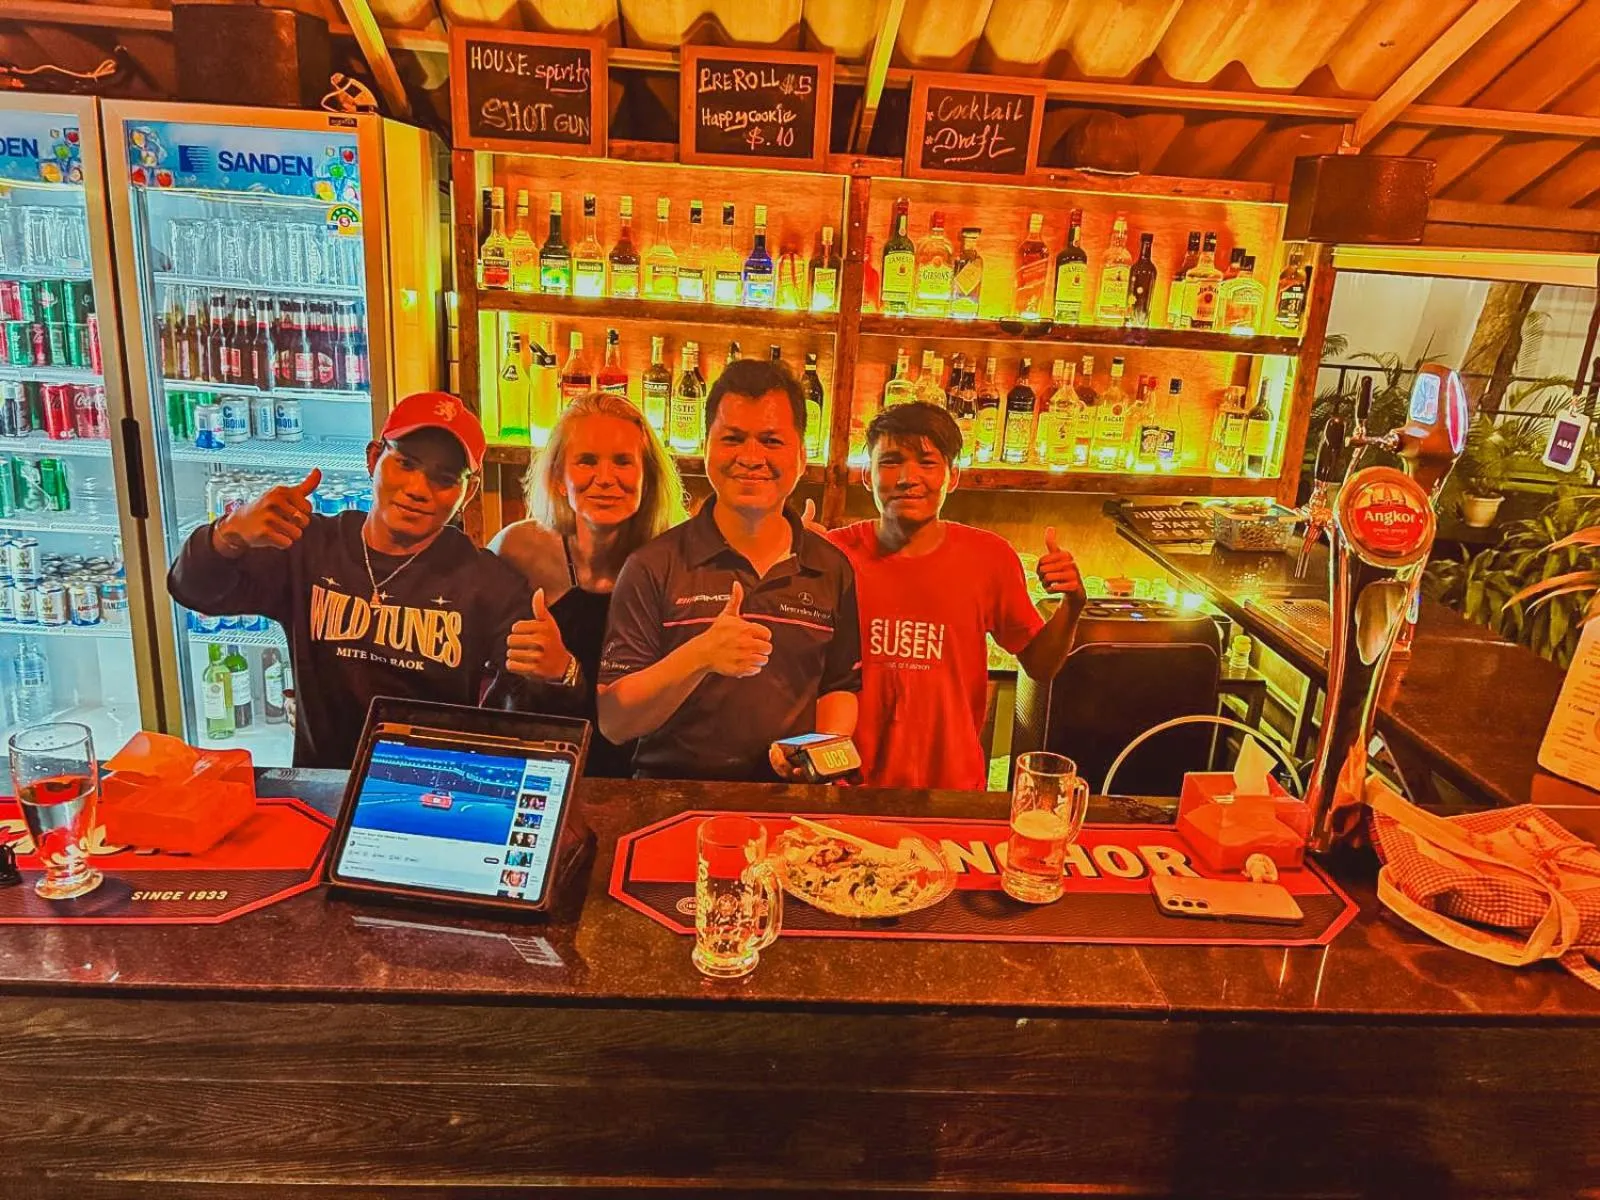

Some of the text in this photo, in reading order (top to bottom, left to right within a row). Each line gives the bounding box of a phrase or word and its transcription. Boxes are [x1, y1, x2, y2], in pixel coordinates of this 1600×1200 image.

[938, 93, 1023, 121] Cocktail
[480, 97, 589, 137] SHOT GUN
[932, 123, 1016, 163] Draft
[217, 150, 314, 177] SANDEN
[1556, 438, 1573, 450] ABA
[1151, 520, 1201, 529] STAFF
[1364, 510, 1416, 526] Angkor
[692, 594, 733, 603] AMG
[310, 584, 462, 668] WILD TUNES
[336, 647, 367, 659] MITE
[823, 749, 849, 768] UCB
[131, 890, 229, 901] SINCE 1933
